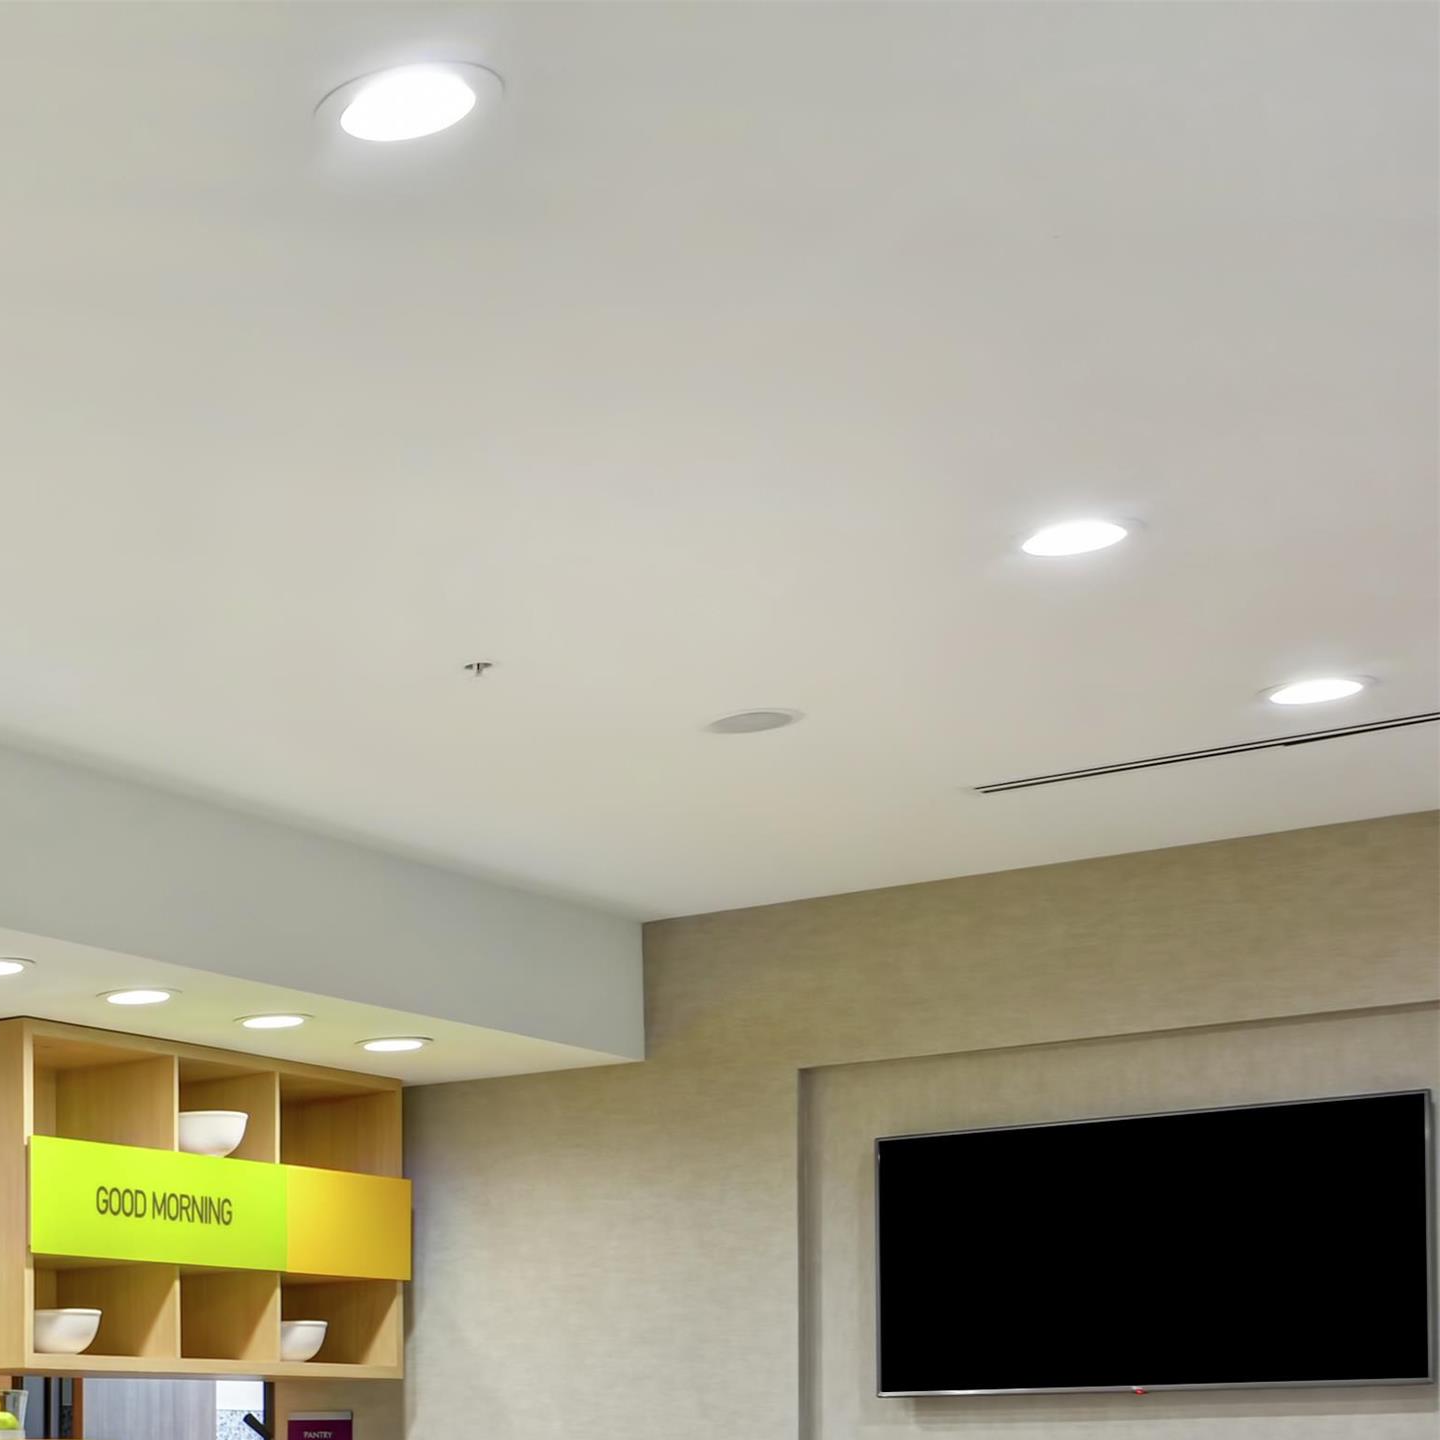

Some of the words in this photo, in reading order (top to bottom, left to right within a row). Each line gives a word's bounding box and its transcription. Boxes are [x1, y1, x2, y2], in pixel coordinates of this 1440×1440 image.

[95, 1186, 147, 1218] GOOD
[152, 1193, 233, 1226] MORNING
[303, 1431, 333, 1439] PANTRY
